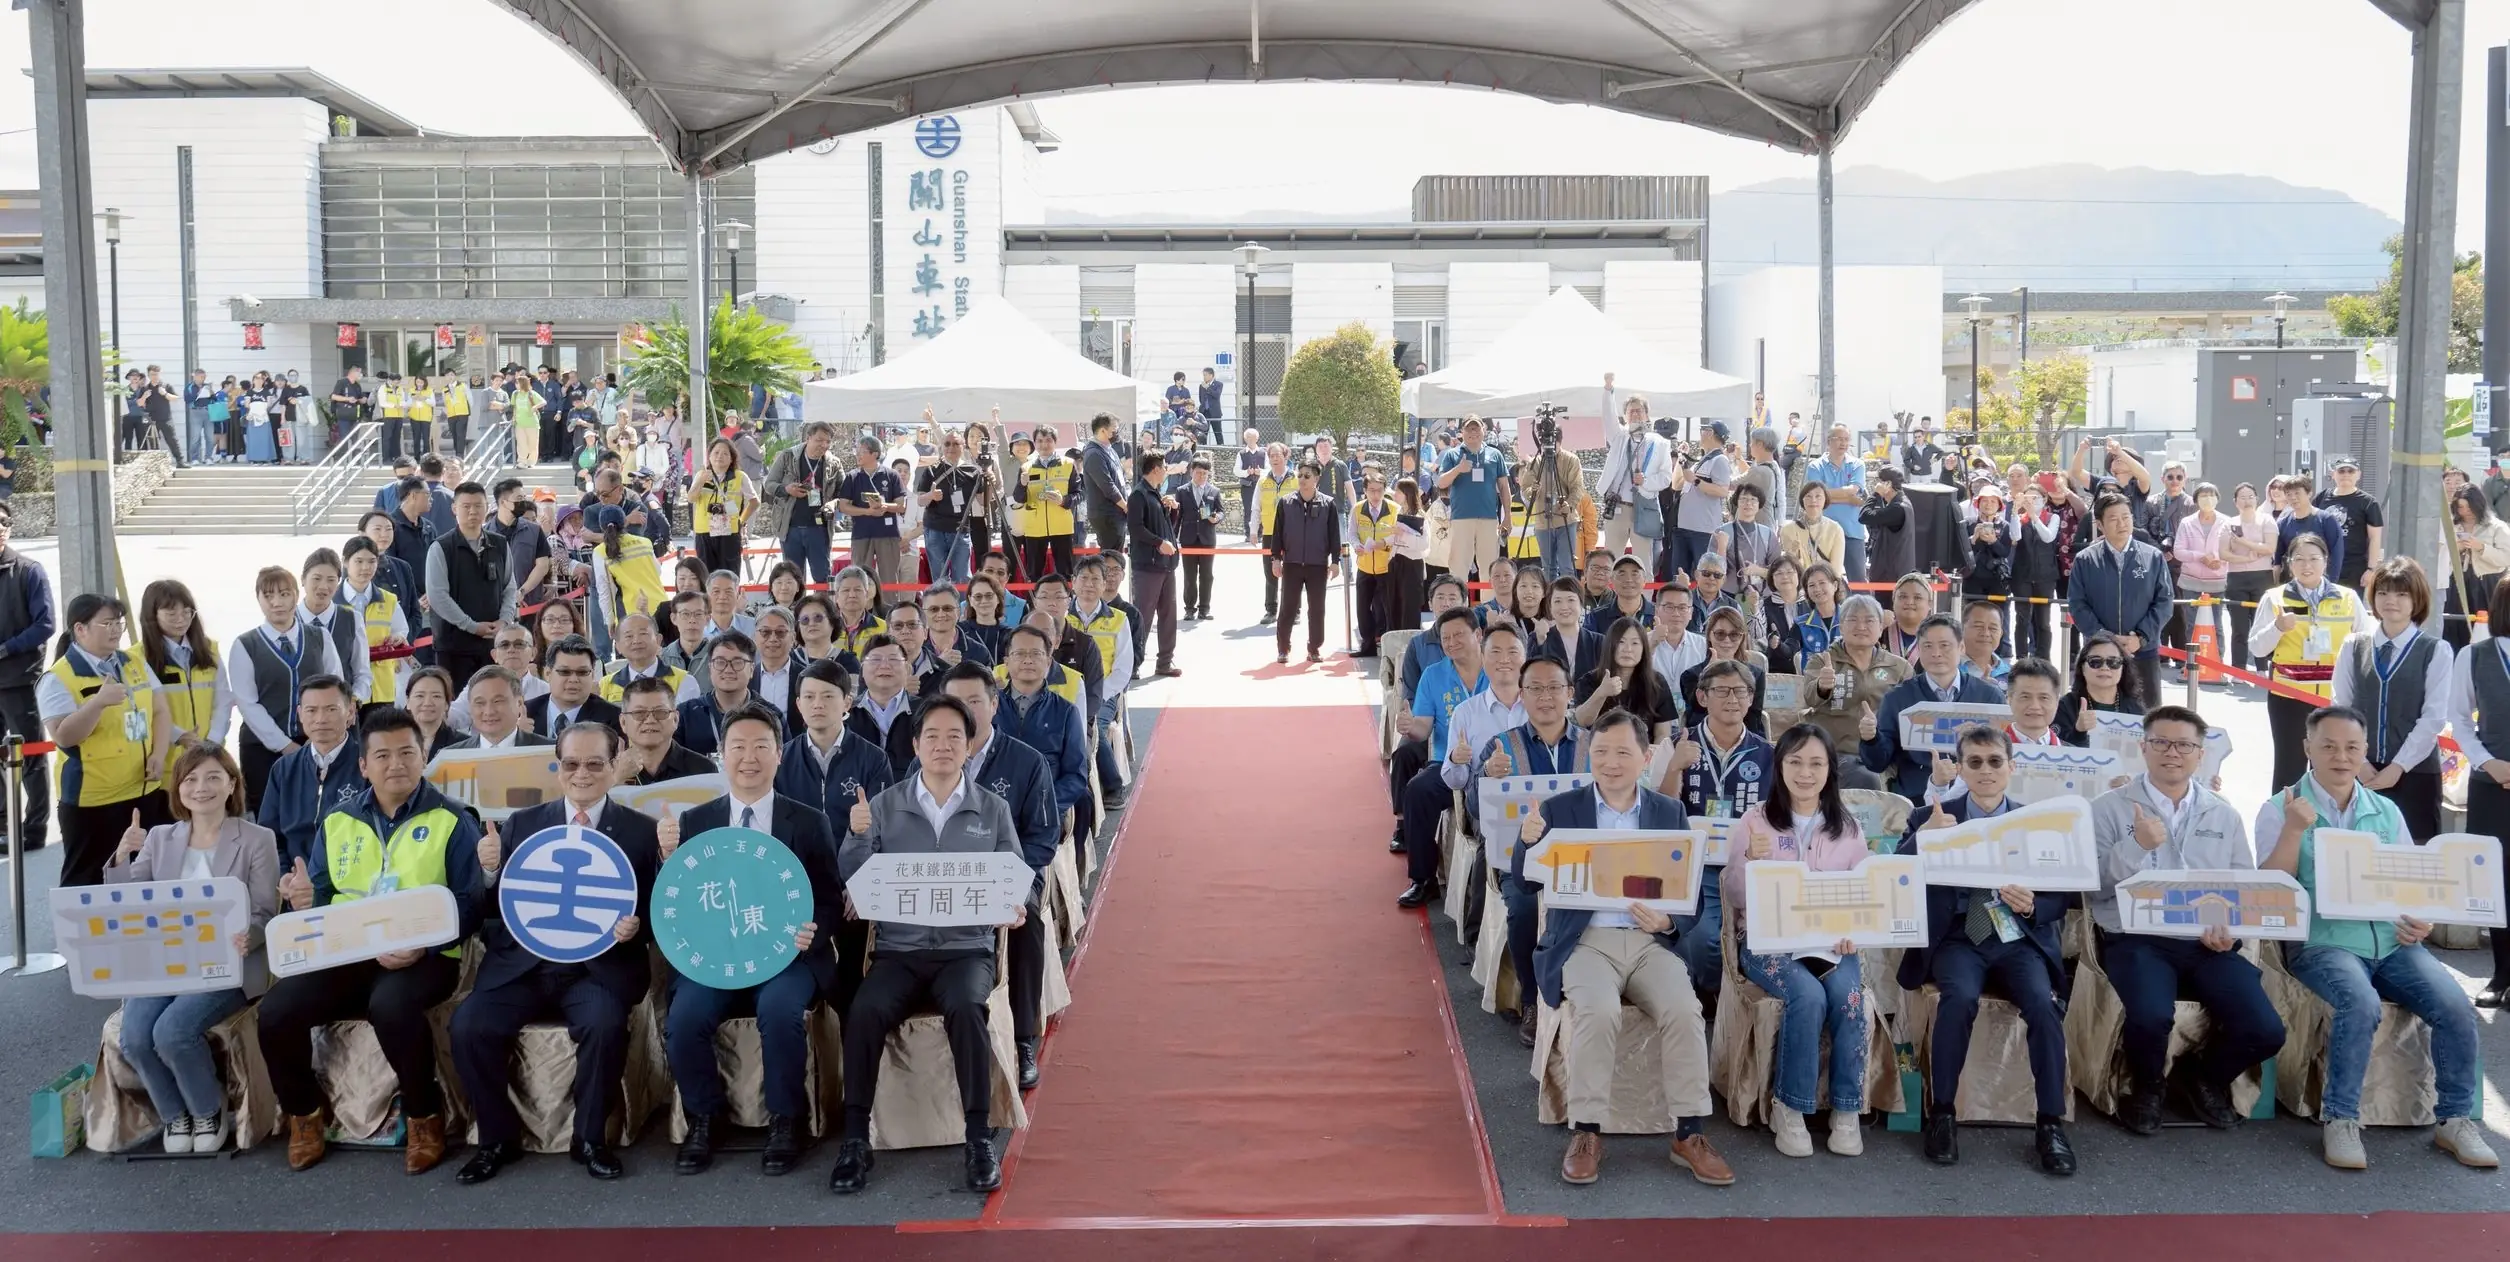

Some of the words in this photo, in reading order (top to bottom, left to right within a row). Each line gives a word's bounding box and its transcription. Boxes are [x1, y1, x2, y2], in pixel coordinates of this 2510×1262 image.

[953, 170, 969, 263] Guanshan
[909, 168, 945, 339] 關山車站
[735, 840, 768, 860] 玉里
[1779, 836, 1794, 851] 陳
[778, 868, 801, 902] 東里
[895, 861, 988, 878] 花東鐵路通車
[870, 867, 882, 911] 1926
[894, 886, 988, 916] 百周年
[1003, 864, 1014, 910] 2026
